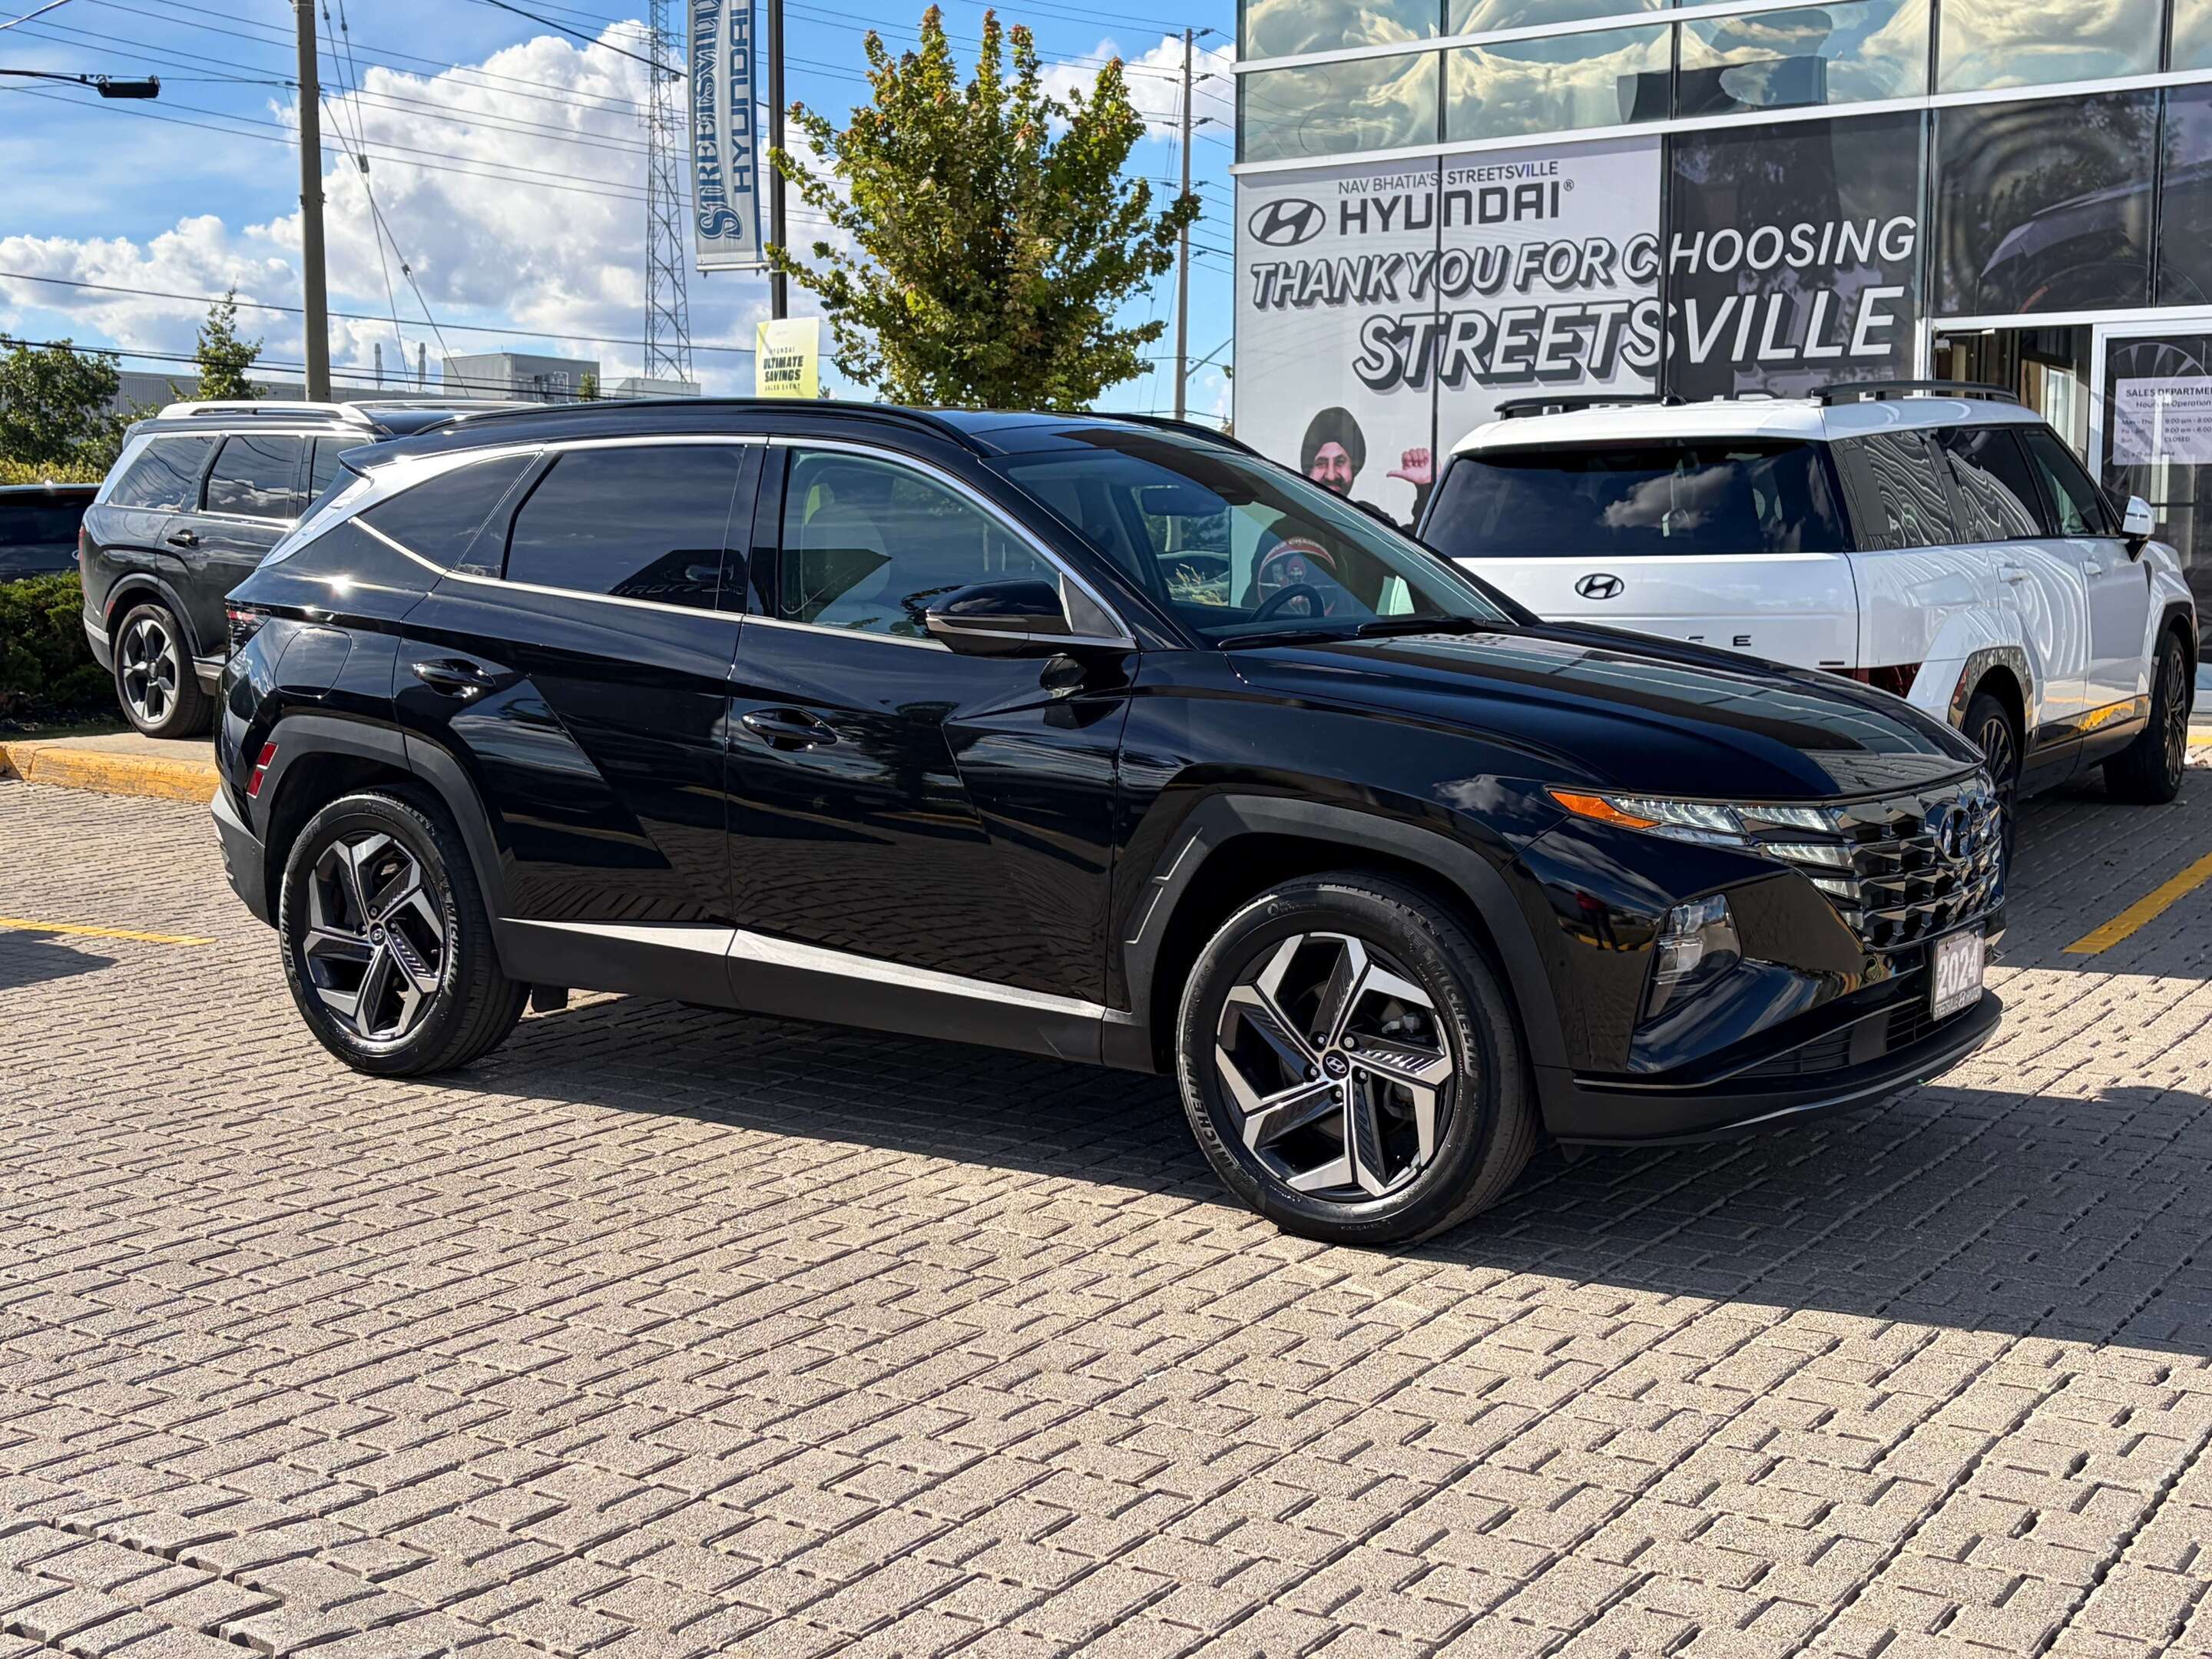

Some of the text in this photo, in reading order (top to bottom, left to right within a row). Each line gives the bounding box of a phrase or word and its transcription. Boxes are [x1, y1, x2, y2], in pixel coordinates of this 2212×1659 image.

[693, 0, 743, 239] STREETSVILL
[730, 8, 751, 193] HYUNDAI
[1339, 161, 1558, 195] NAV BHATIA'S STREETSVILLE
[1250, 215, 1917, 309] THANK YOU FOR CHOOSING
[763, 355, 804, 369] ULTIMATE
[1353, 286, 1906, 390] STREETSVILLE
[765, 369, 801, 382] SAVINGS
[2126, 387, 2212, 397] SALES DEPARTME
[2171, 399, 2211, 409] Operation
[1936, 942, 1979, 1002] 2024
[1185, 1058, 1233, 1168] MICHELIN
